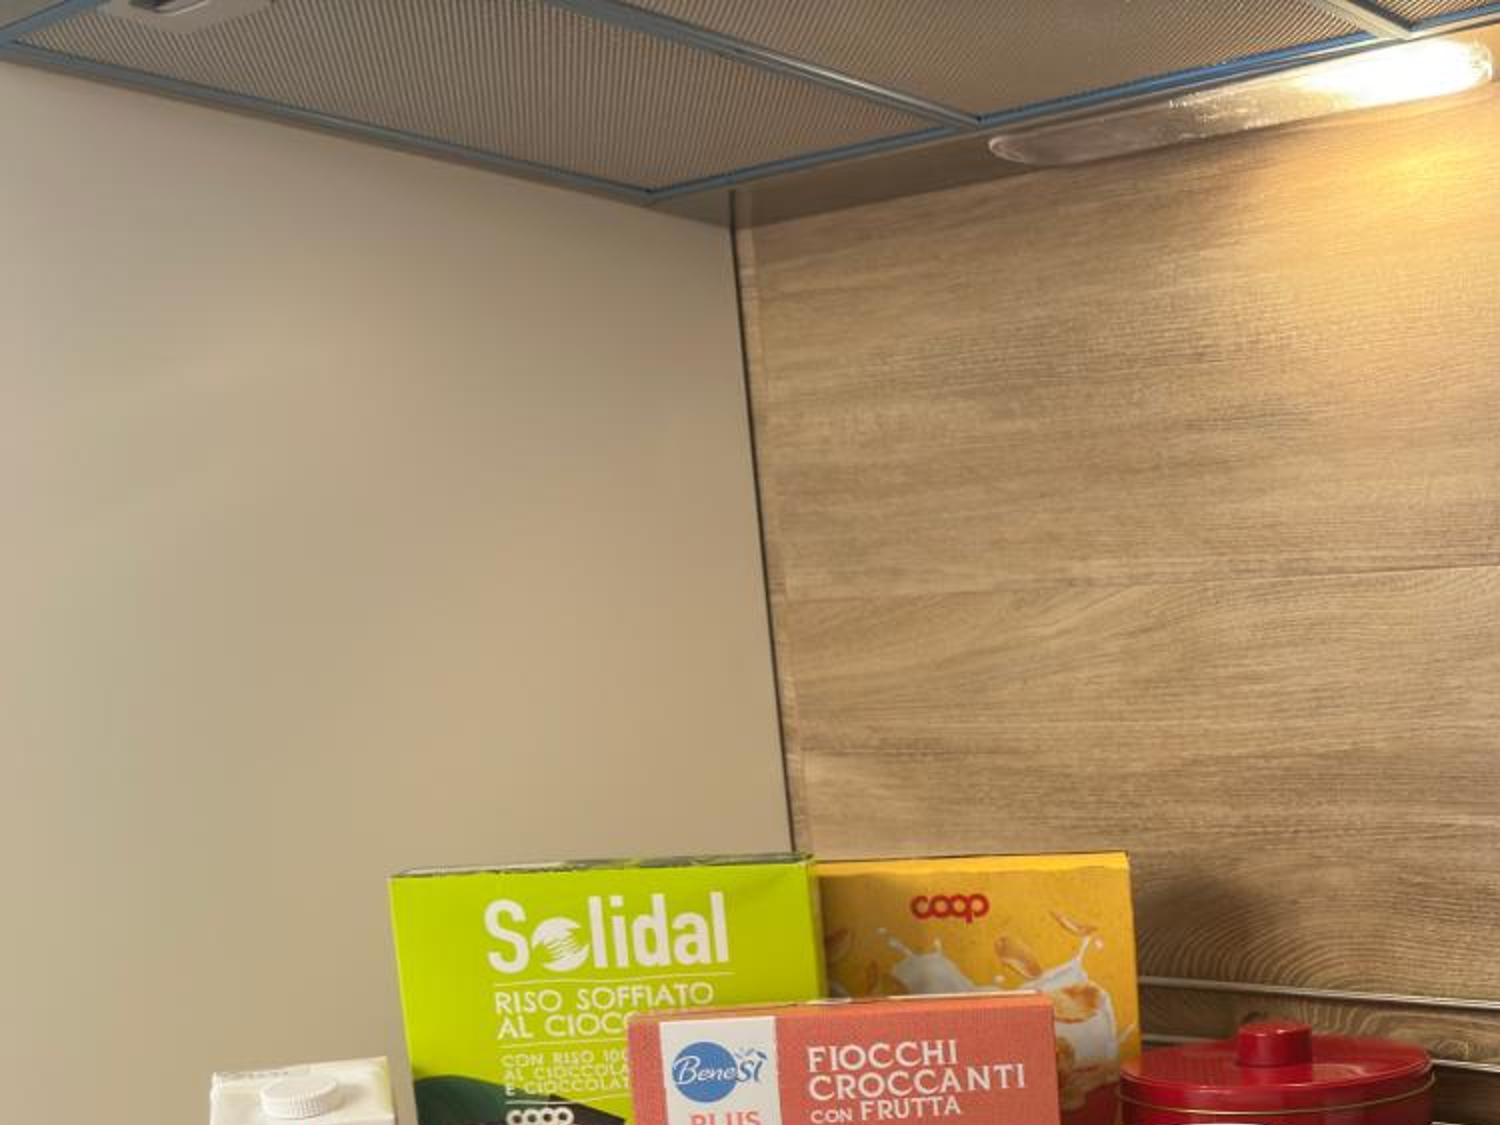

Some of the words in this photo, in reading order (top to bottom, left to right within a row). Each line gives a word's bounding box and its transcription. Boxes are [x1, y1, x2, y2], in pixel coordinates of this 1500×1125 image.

[910, 893, 989, 924] coop
[484, 891, 730, 974] Solidal
[495, 988, 564, 1015] RISO
[574, 981, 714, 1012] SOFFIATO
[497, 1014, 534, 1040] AL
[807, 1040, 958, 1073] FIOCCHI
[808, 1064, 1026, 1101] CROCCANTI
[810, 1109, 853, 1125] CON
[860, 1096, 962, 1121] FRUTTA
